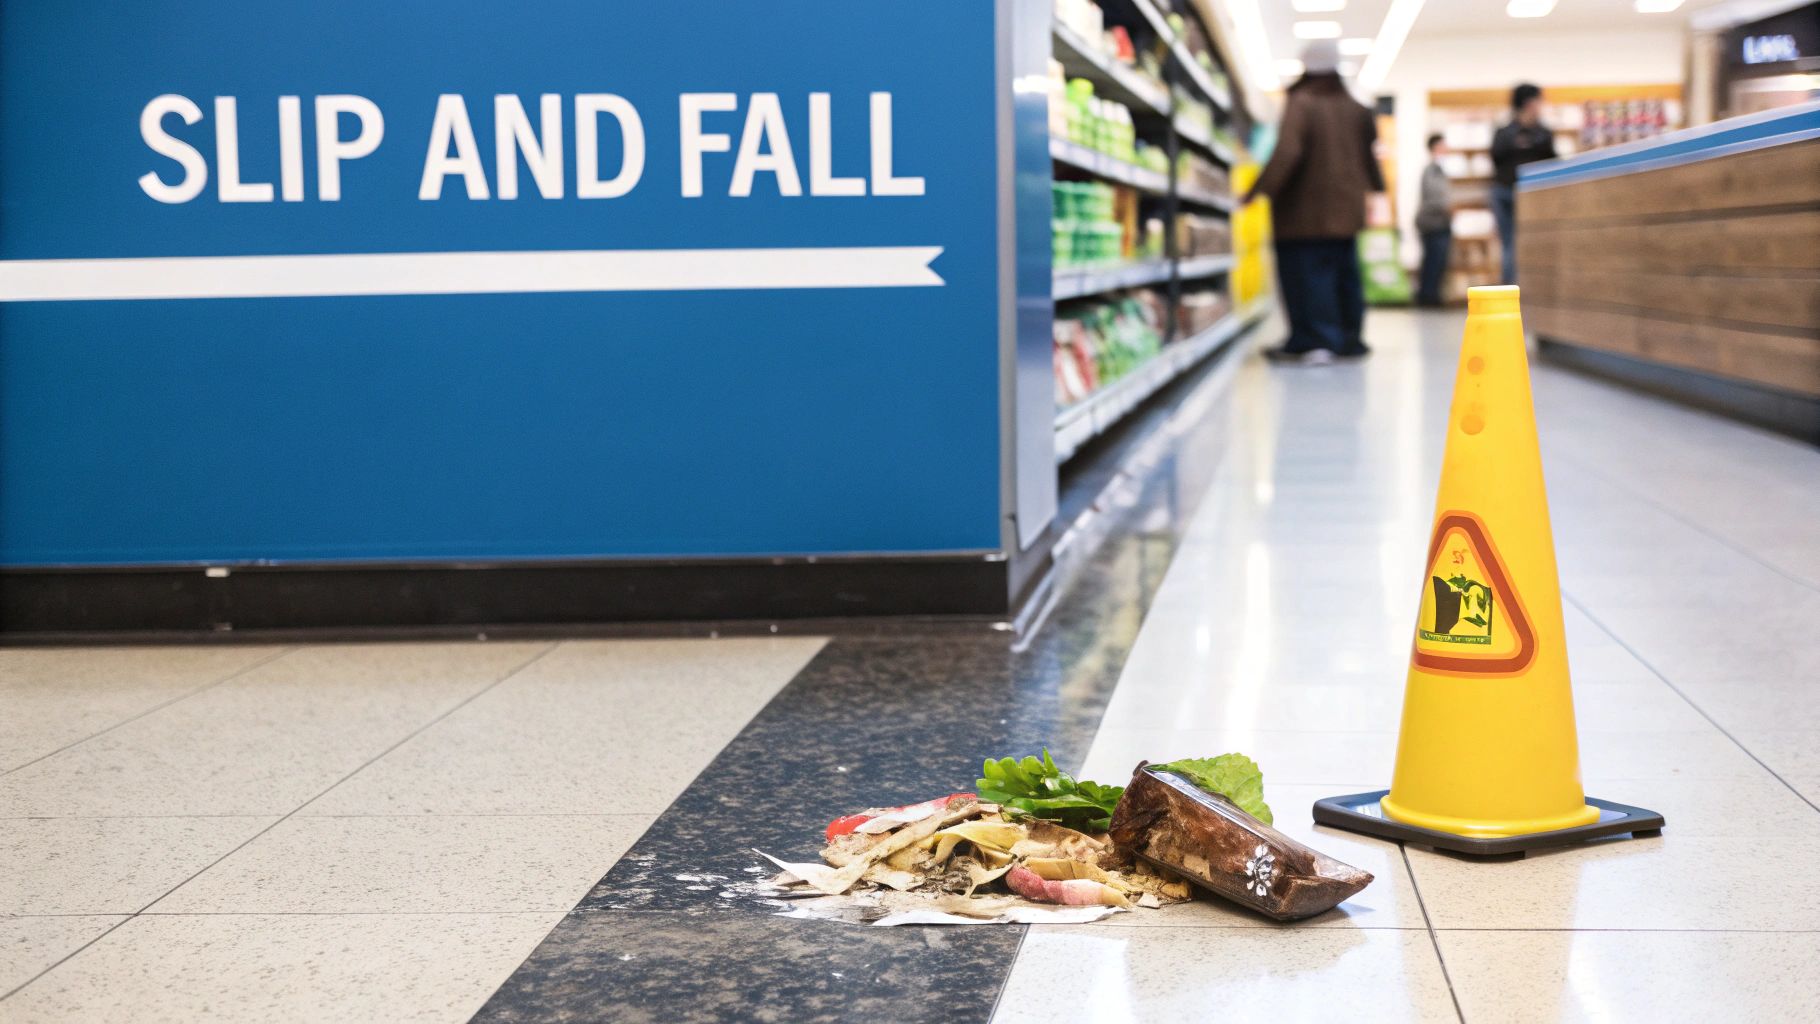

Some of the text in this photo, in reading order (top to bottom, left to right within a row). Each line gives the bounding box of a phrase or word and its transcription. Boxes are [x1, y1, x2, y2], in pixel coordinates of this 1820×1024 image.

[138, 91, 926, 205] SLIP AND FALL
